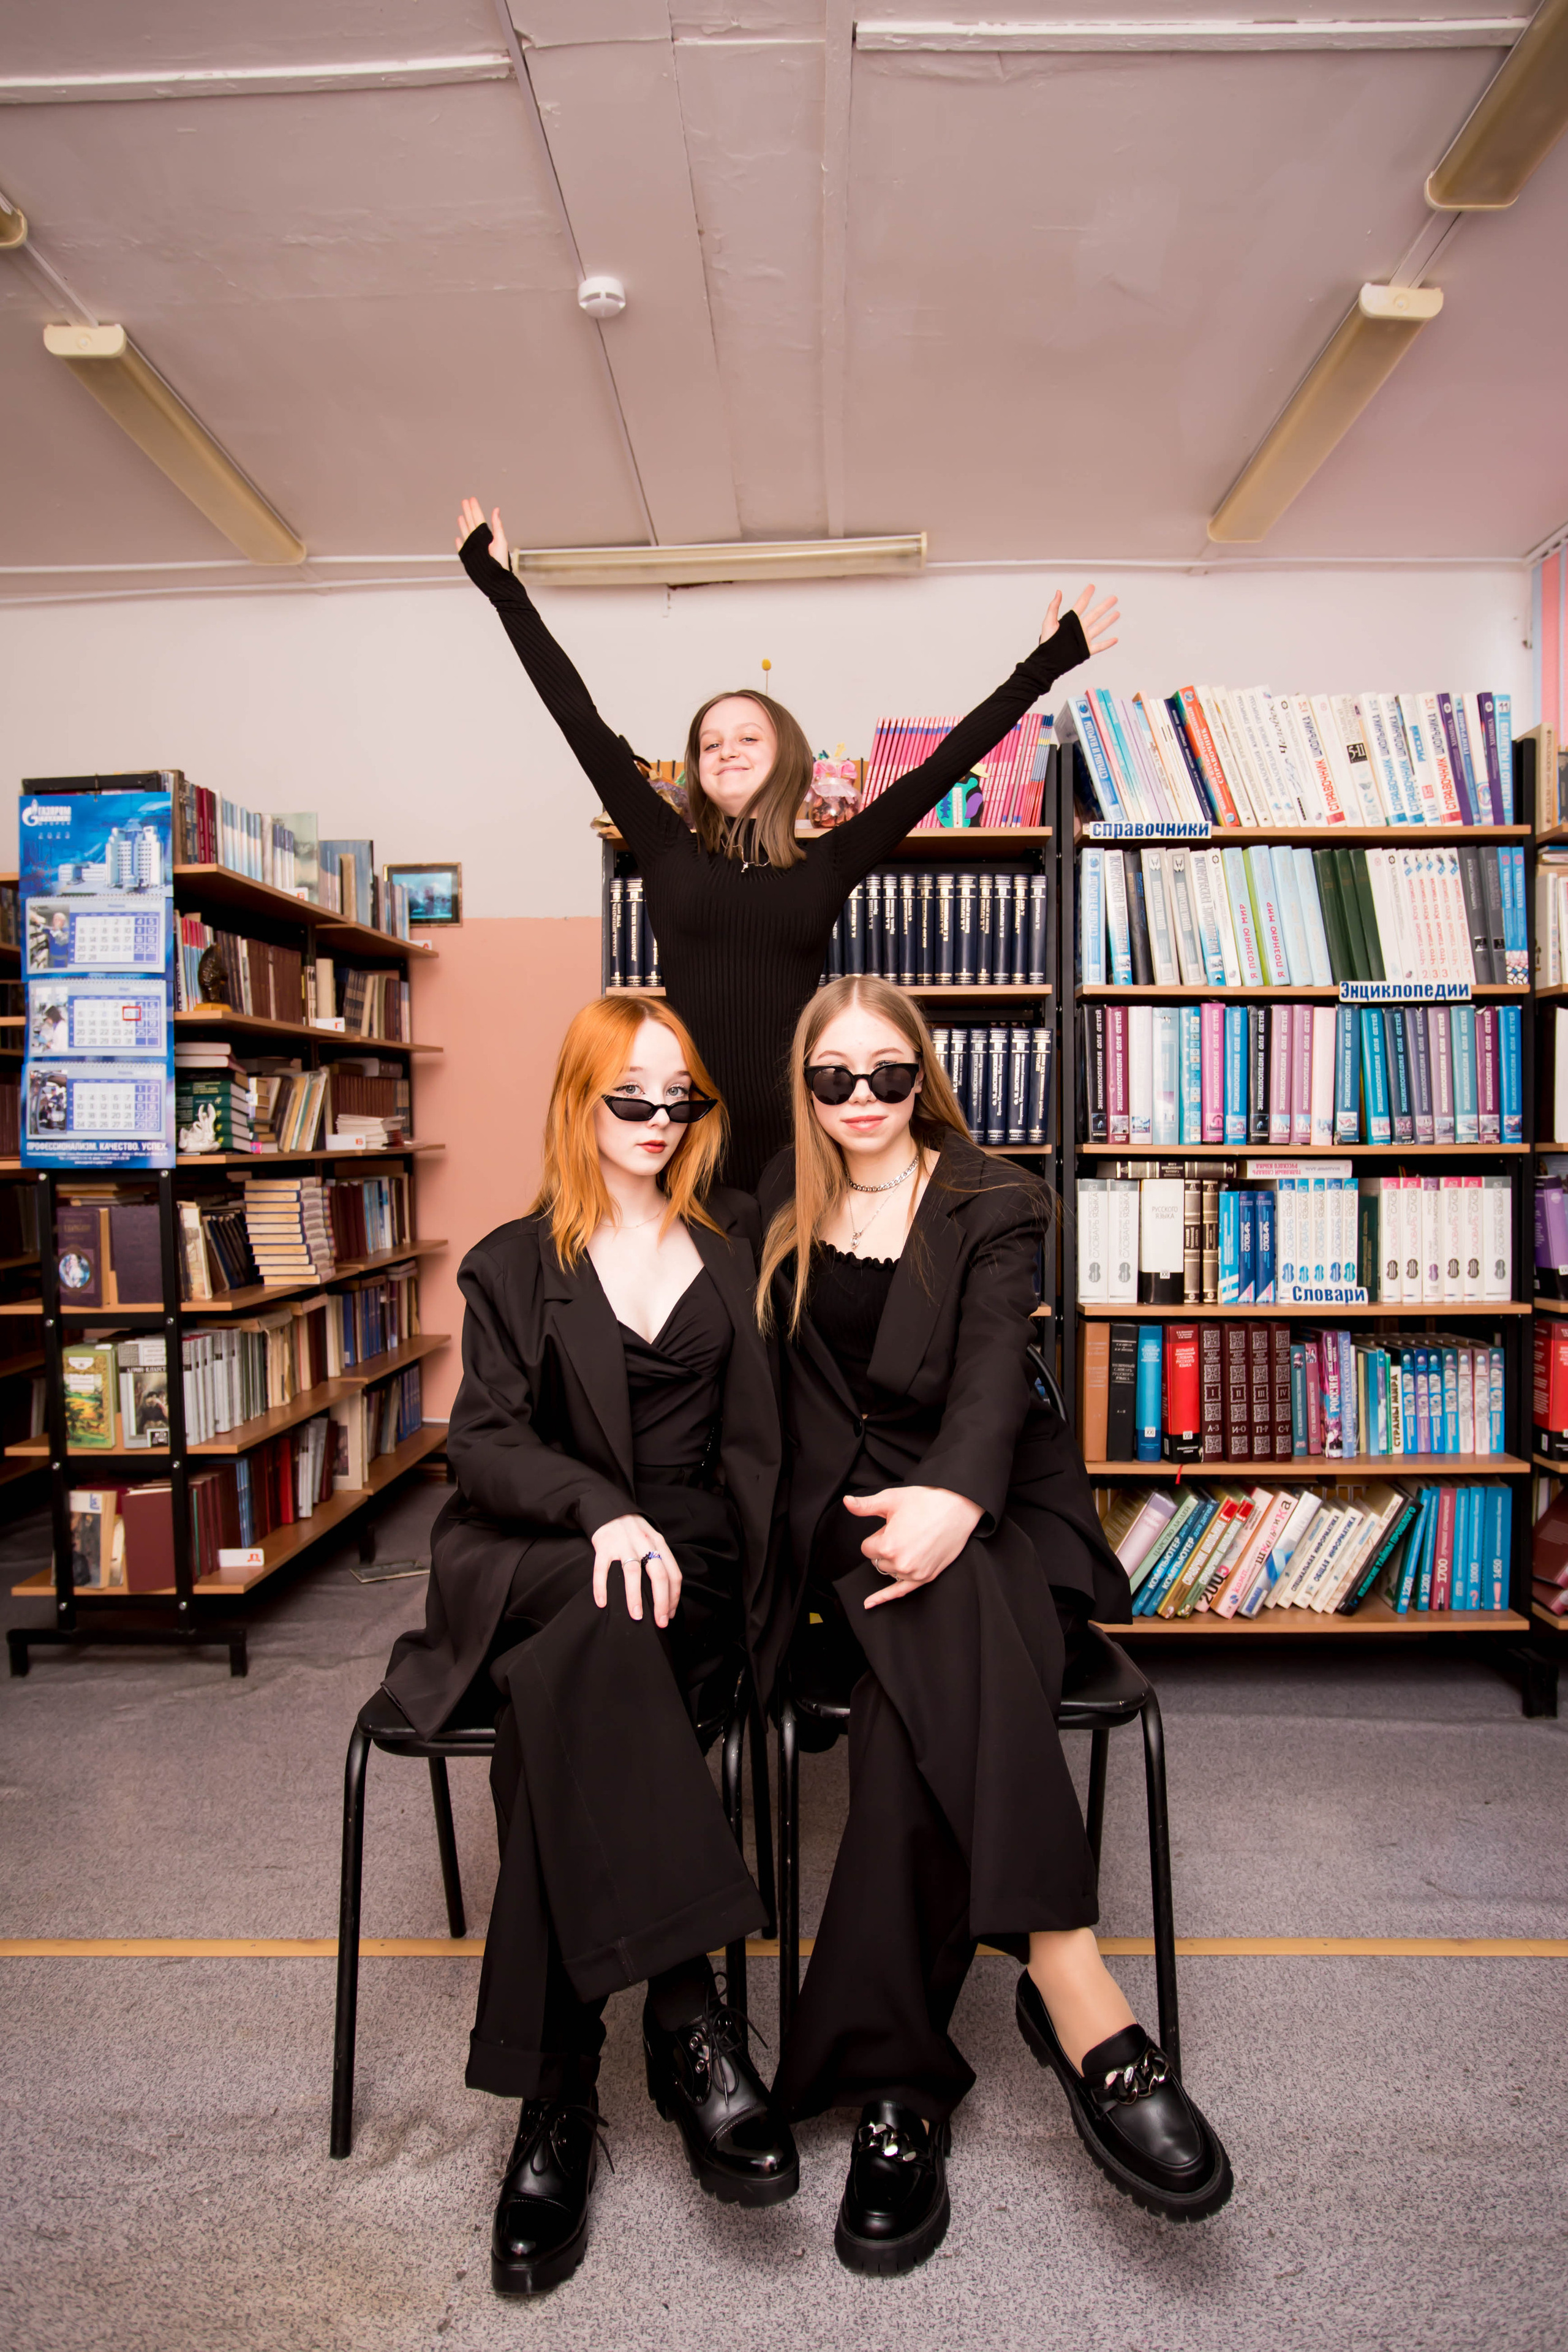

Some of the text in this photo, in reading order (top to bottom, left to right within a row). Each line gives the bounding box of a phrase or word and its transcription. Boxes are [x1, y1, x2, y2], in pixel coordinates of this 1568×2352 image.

[1428, 714, 1445, 755] ШКОЛЬНИКА
[1201, 728, 1223, 783] СПРАВОЧНИК
[1302, 715, 1340, 812] СПРАВОЧНИК ШКОЛЬНИКА
[1373, 714, 1403, 811] СПРАВОЧНИК ШКОЛЬНИКА
[1389, 715, 1420, 812] СПРАВОЧНИК ШКОЛЬНИКА
[1436, 757, 1457, 809] СПРАВОЧНИК
[1093, 823, 1209, 839] справочники
[1239, 903, 1248, 924] МИР
[1267, 902, 1275, 922] МИР
[1243, 928, 1256, 968] ПОЗНАЮ
[1270, 926, 1283, 967] ПОЗНАЮ
[1341, 982, 1469, 1001] Энциклопедии
[1375, 1055, 1384, 1112] ЭНЦИКЛОПЕДИЯ
[26, 1142, 168, 1151] ПРОФЕССИОНАЛИЗМ. КАЧЕСТВО. УСПЕХ.
[1292, 1286, 1365, 1305] Словари
[1329, 1375, 1340, 1412] РОССИЯ
[1392, 1406, 1400, 1447] СТРАНЫ
[1153, 1506, 1191, 1556] ЦАРСТВО ЛЮДЕЙ
[1161, 1504, 1214, 1589] КОМПЬЮТЕР для детей
[1255, 1500, 1291, 1564] школьника
[1313, 1517, 1356, 1582] ОБЩАЯ ИНФОРМАТИКА
[1357, 1506, 1416, 1597] ВЕЛИКИЕ ТАЙНЫ ПРОШЛОГО
[1148, 1524, 1189, 1589] КОМПЬЮТЕР для
[1182, 1518, 1227, 1586] СПРАВОЧНИК ШКОЛЬНИКА
[1198, 1519, 1242, 1585] СПРАВОЧНИК ШКОЛЬНИКА
[1291, 1515, 1340, 1592] СПЕЦИАЛЬНАЯ ИНФОРМАТИКА
[1437, 1558, 1448, 1583] 1700
[1470, 1562, 1479, 1583] 1000
[1493, 1559, 1502, 1578] 1450
[1199, 1565, 1229, 1604] 2005
[1401, 1577, 1413, 1596] 1200
[1421, 1574, 1431, 1593] 1200
